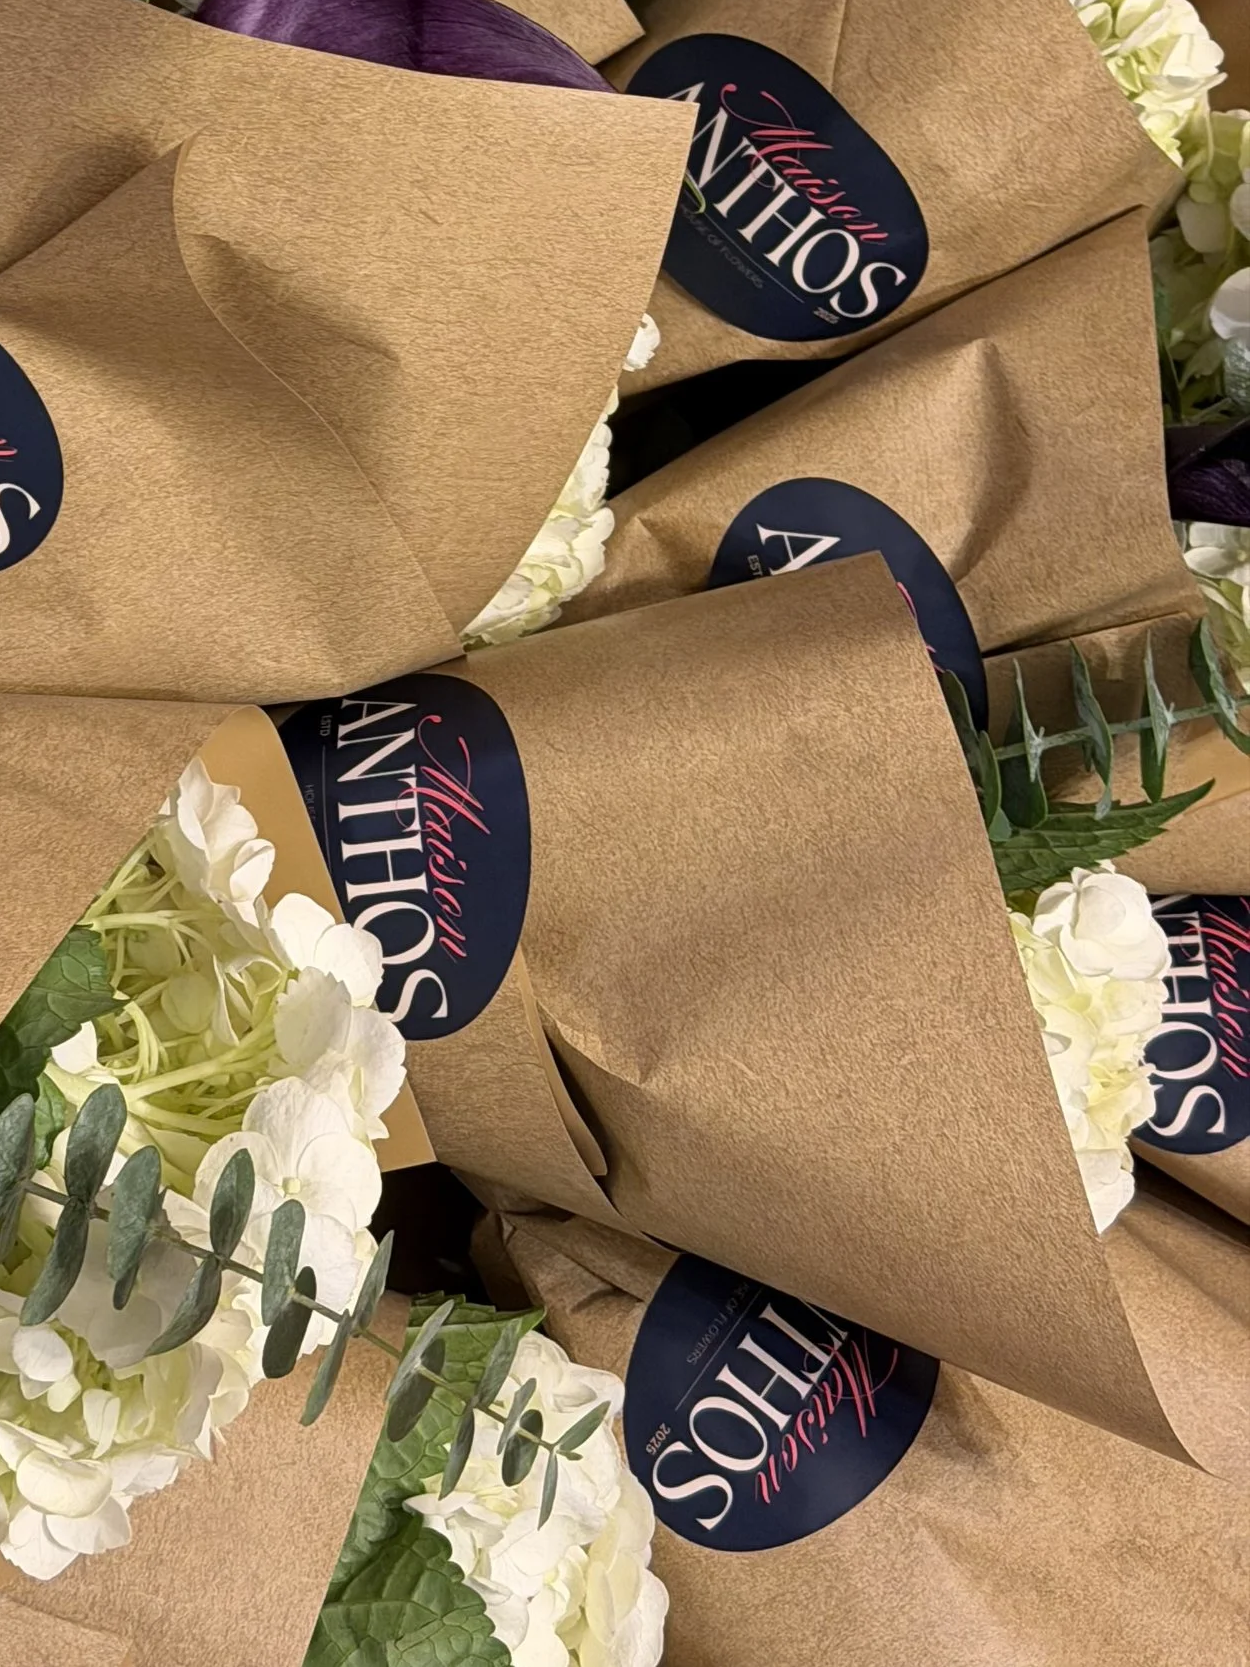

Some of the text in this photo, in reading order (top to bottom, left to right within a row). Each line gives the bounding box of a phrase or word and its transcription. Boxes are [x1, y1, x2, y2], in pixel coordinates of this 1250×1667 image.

[720, 84, 889, 246] Maison
[336, 698, 449, 1023] ANTHOS
[394, 714, 492, 964] Maison
[645, 1421, 672, 1457] 2025
